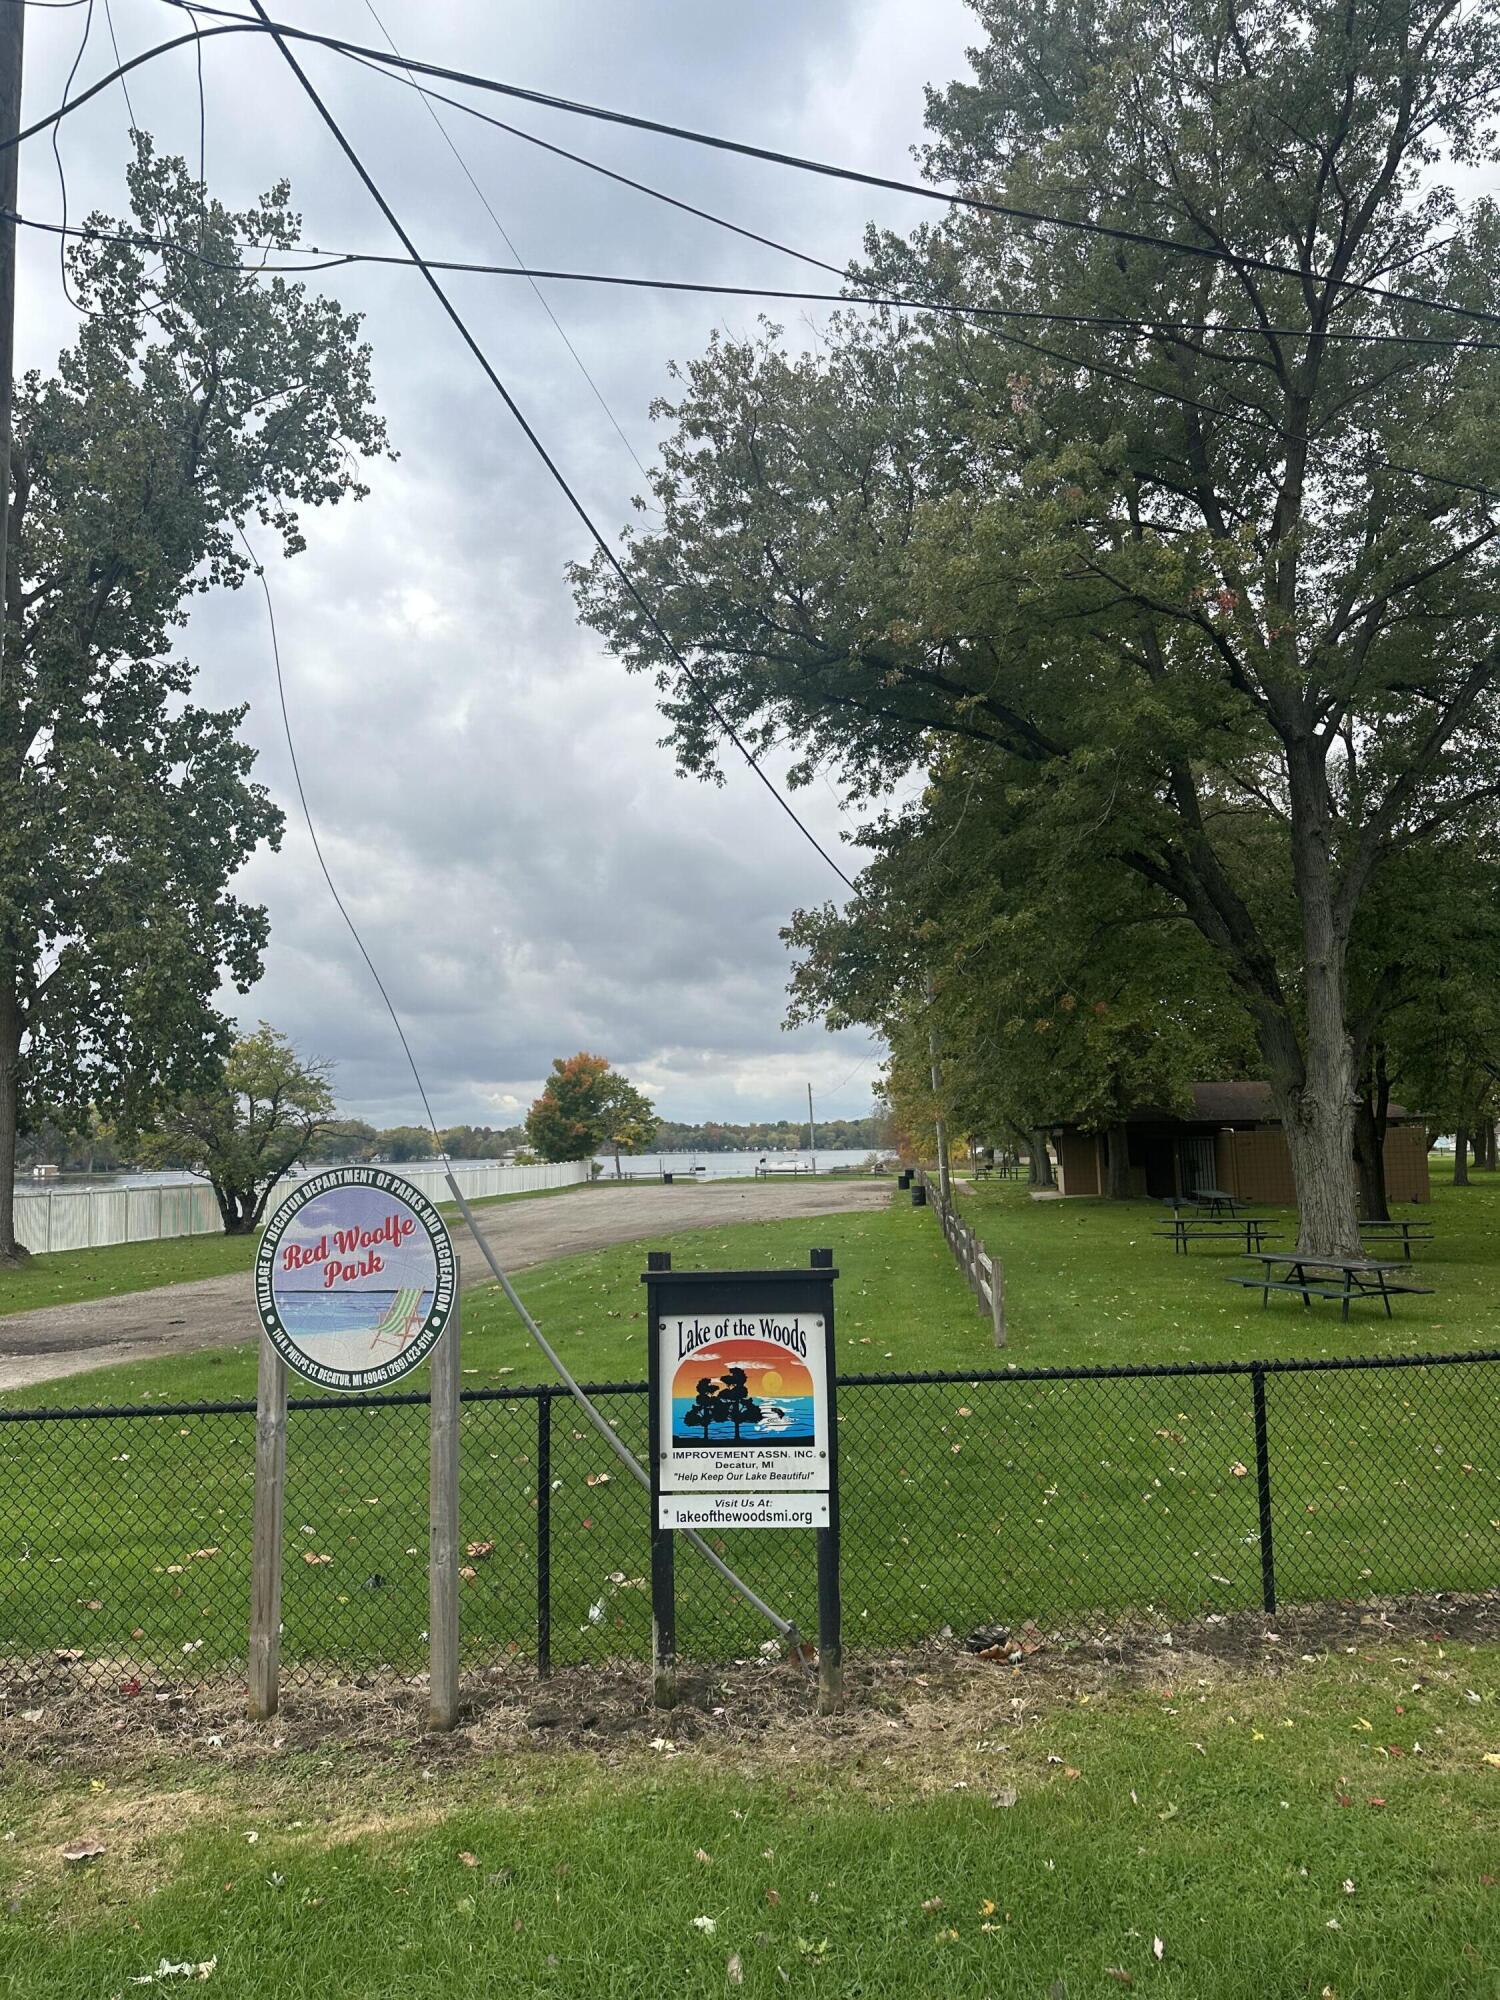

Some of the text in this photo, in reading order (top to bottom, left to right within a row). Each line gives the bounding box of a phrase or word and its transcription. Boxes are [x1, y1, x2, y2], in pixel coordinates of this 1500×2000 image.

[257, 1169, 453, 1313] VILLAGE OF DECATUR DEPARTMENT OF PARKS AND RECREATION
[283, 1214, 417, 1271] Red Woolfe
[324, 1249, 385, 1288] Park
[677, 1318, 807, 1362] Lake of the Woods
[271, 1327, 284, 1344] 114
[284, 1344, 310, 1371] PHELPS
[317, 1367, 352, 1387] DECATUR,
[352, 1374, 363, 1387] MI
[363, 1367, 388, 1385] 49045
[387, 1356, 409, 1377] (269)
[405, 1329, 435, 1363] 423-6114
[672, 1450, 817, 1460] IMPROVEMENT ASSN. INC.
[715, 1461, 774, 1470] Decatur, MI
[673, 1471, 815, 1483] "Help Keep Our Lake Beautiful"
[676, 1509, 813, 1525] lakeofthewoodsmi.org
[715, 1499, 773, 1508] Visit Us At:
